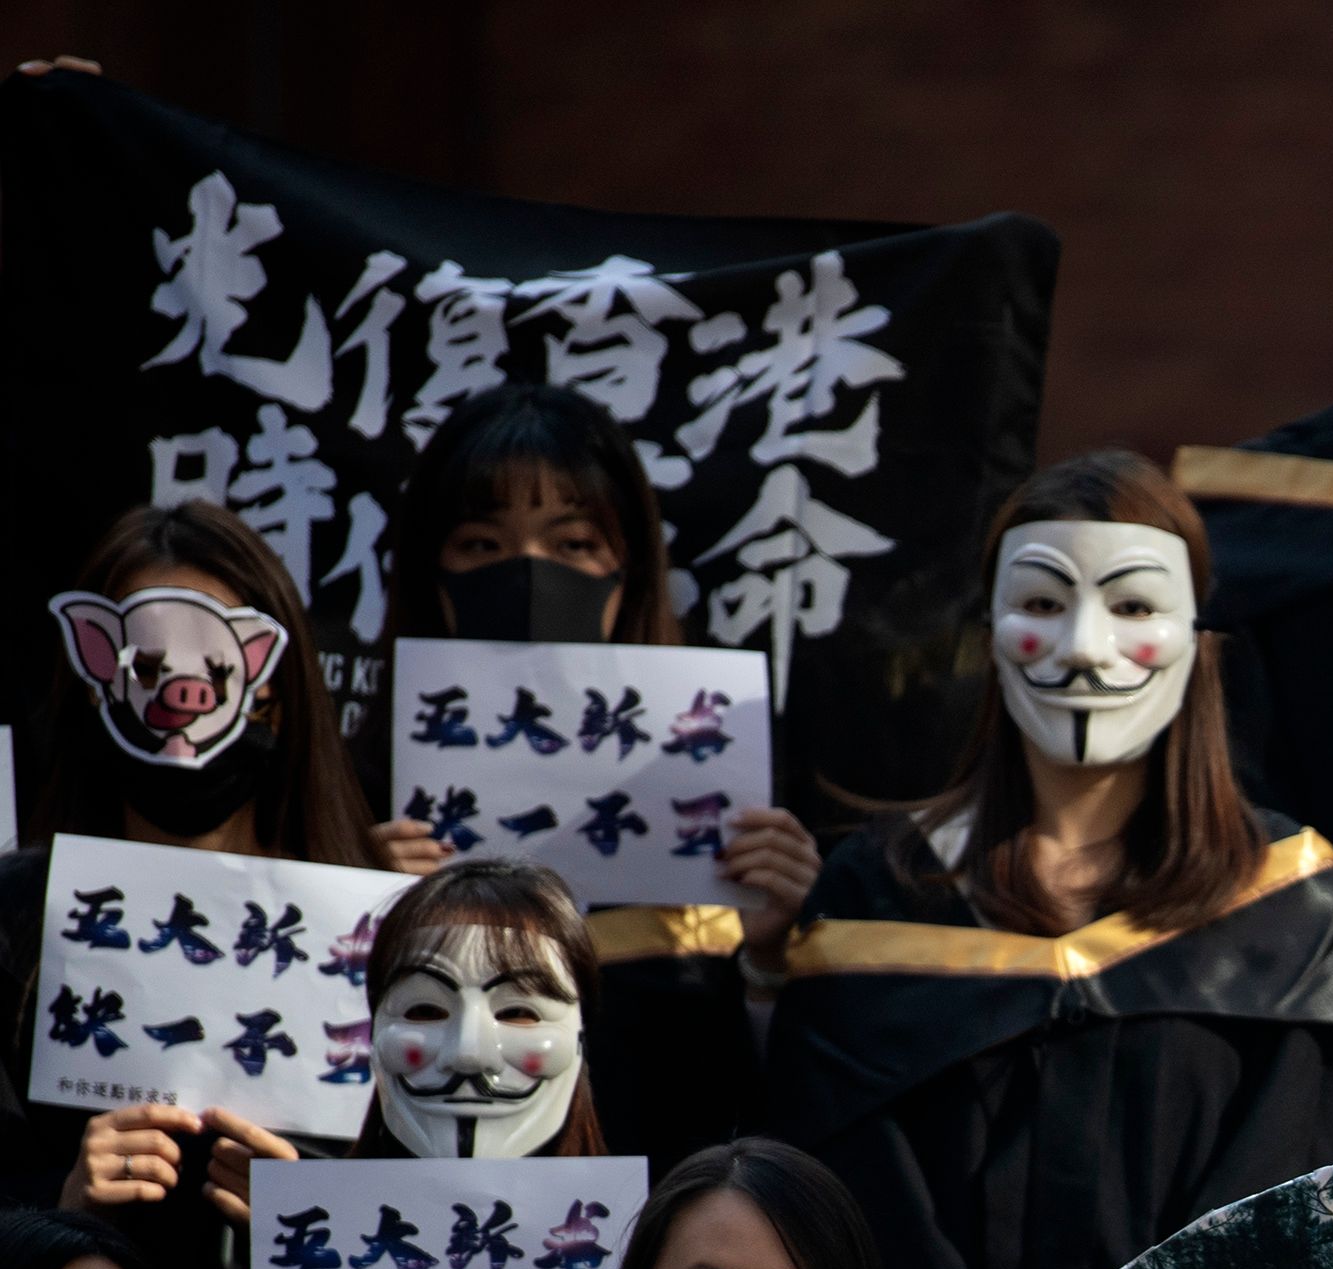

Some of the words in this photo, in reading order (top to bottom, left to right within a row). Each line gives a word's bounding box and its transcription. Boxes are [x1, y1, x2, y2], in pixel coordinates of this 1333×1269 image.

[141, 169, 905, 476] 光復香港
[151, 404, 895, 713] 時命
[410, 686, 735, 763] 五大訴求
[404, 785, 731, 858] 缺一不可
